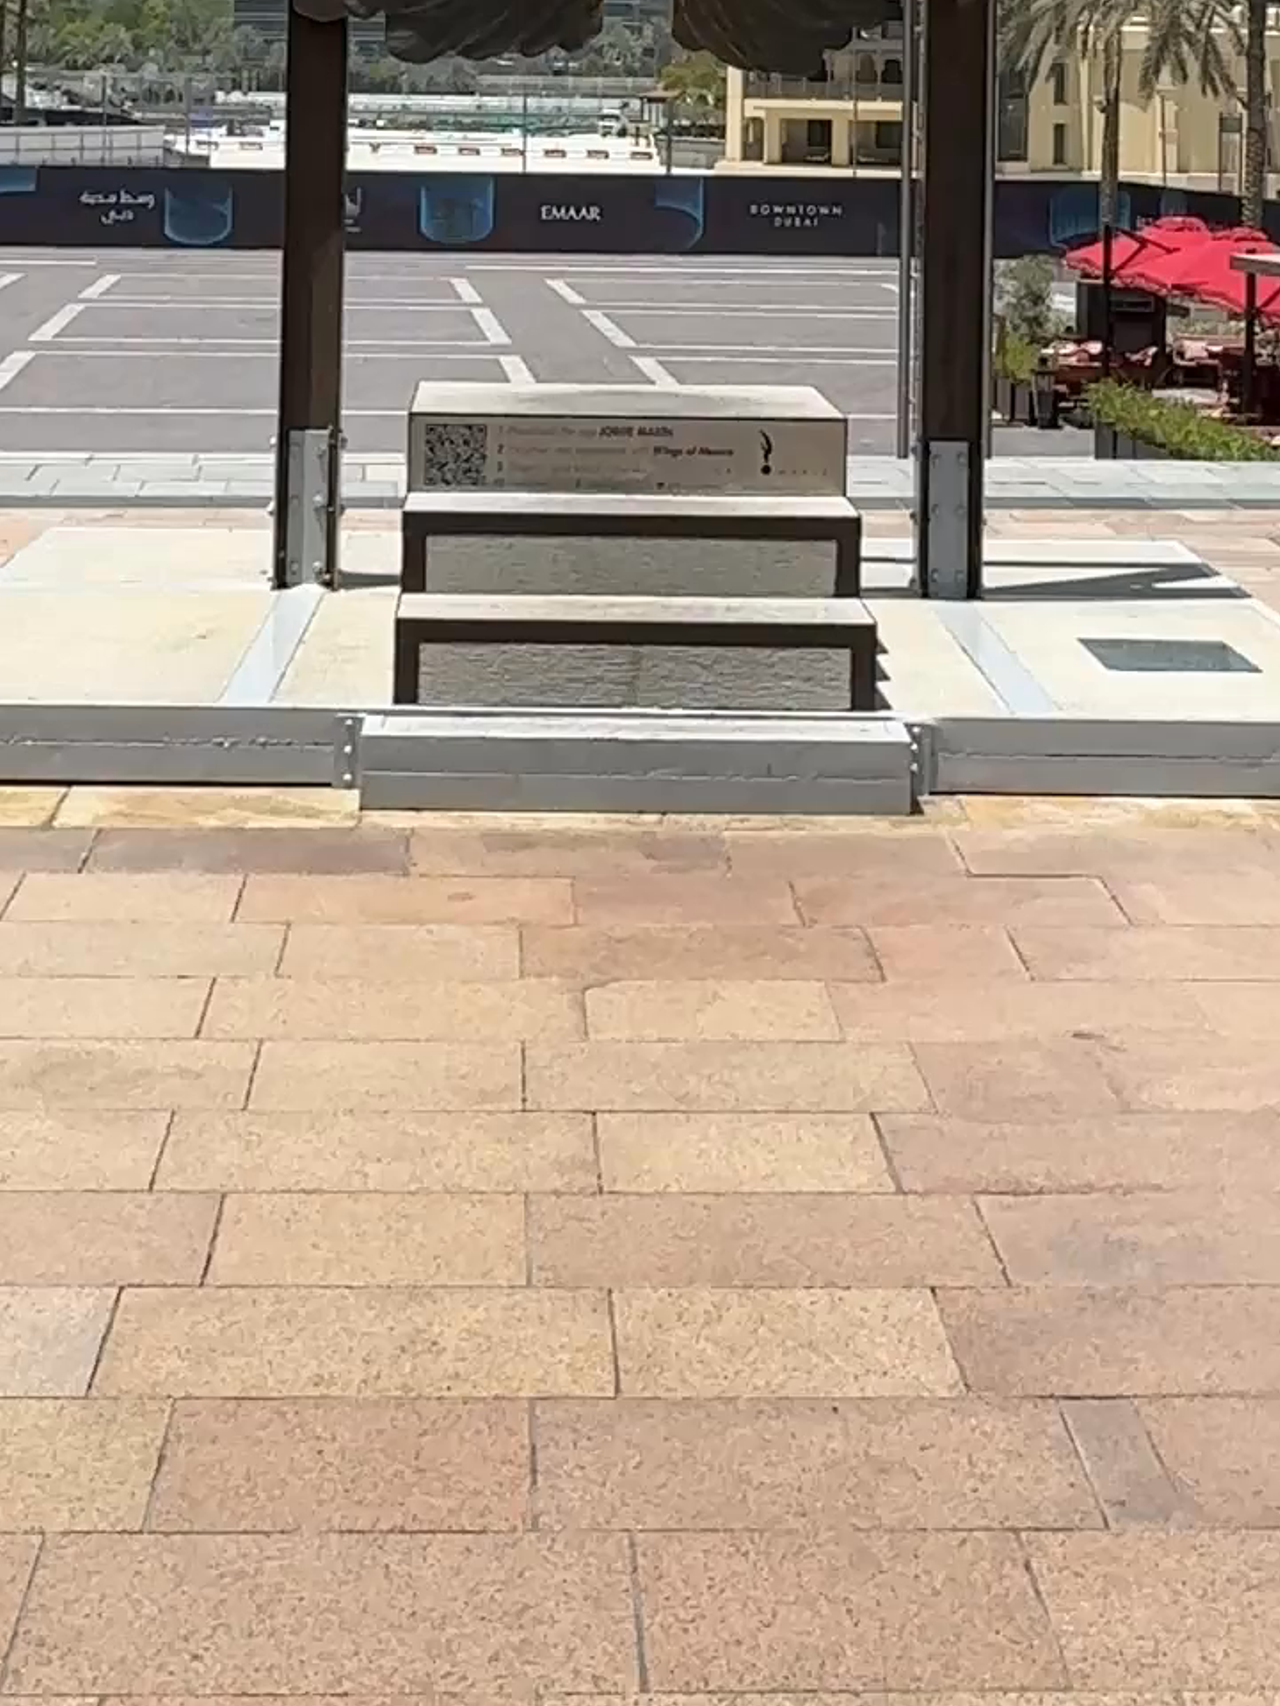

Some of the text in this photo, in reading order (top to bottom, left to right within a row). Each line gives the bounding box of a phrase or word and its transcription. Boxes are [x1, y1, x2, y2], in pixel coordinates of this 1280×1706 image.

[540, 205, 601, 221] EMAAR
[749, 204, 842, 216] DOWNTOWN
[774, 216, 819, 227] DUBAI
